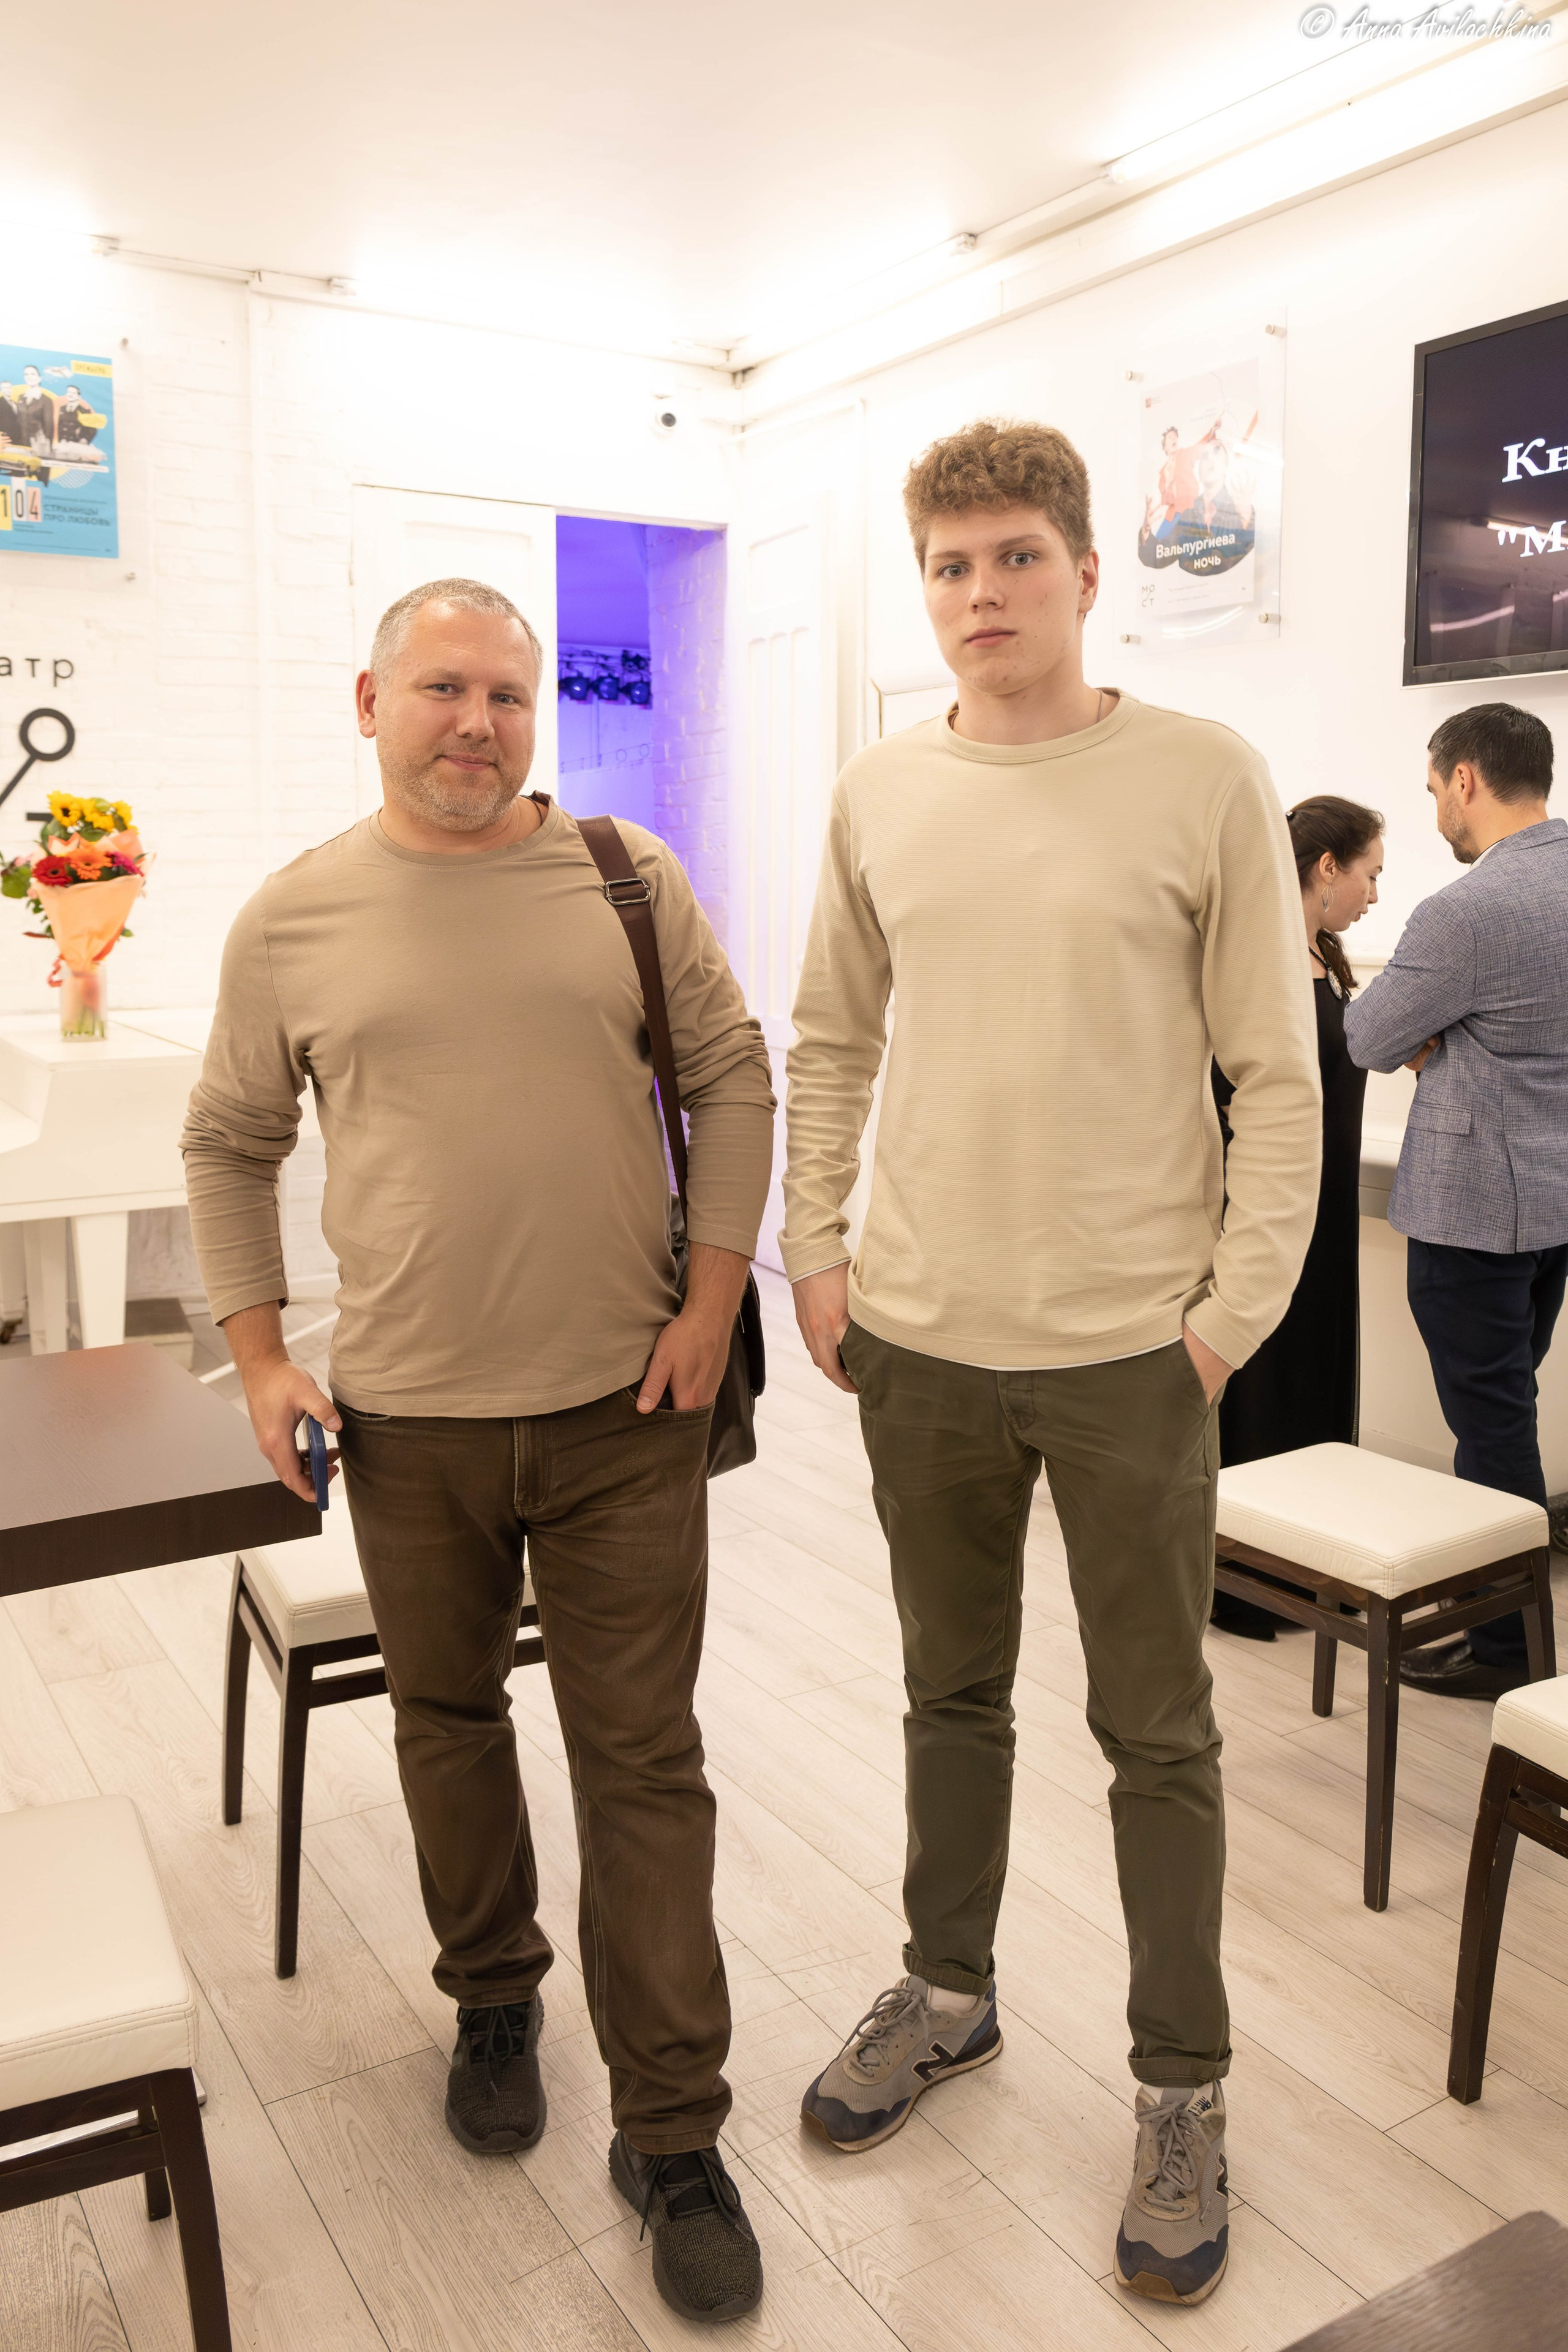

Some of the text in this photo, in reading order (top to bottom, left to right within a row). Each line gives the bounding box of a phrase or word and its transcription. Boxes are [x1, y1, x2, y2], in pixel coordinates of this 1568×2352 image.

[1, 488, 38, 520] 104
[1156, 533, 1235, 559] Вальпургиева
[1194, 556, 1222, 570] ночь
